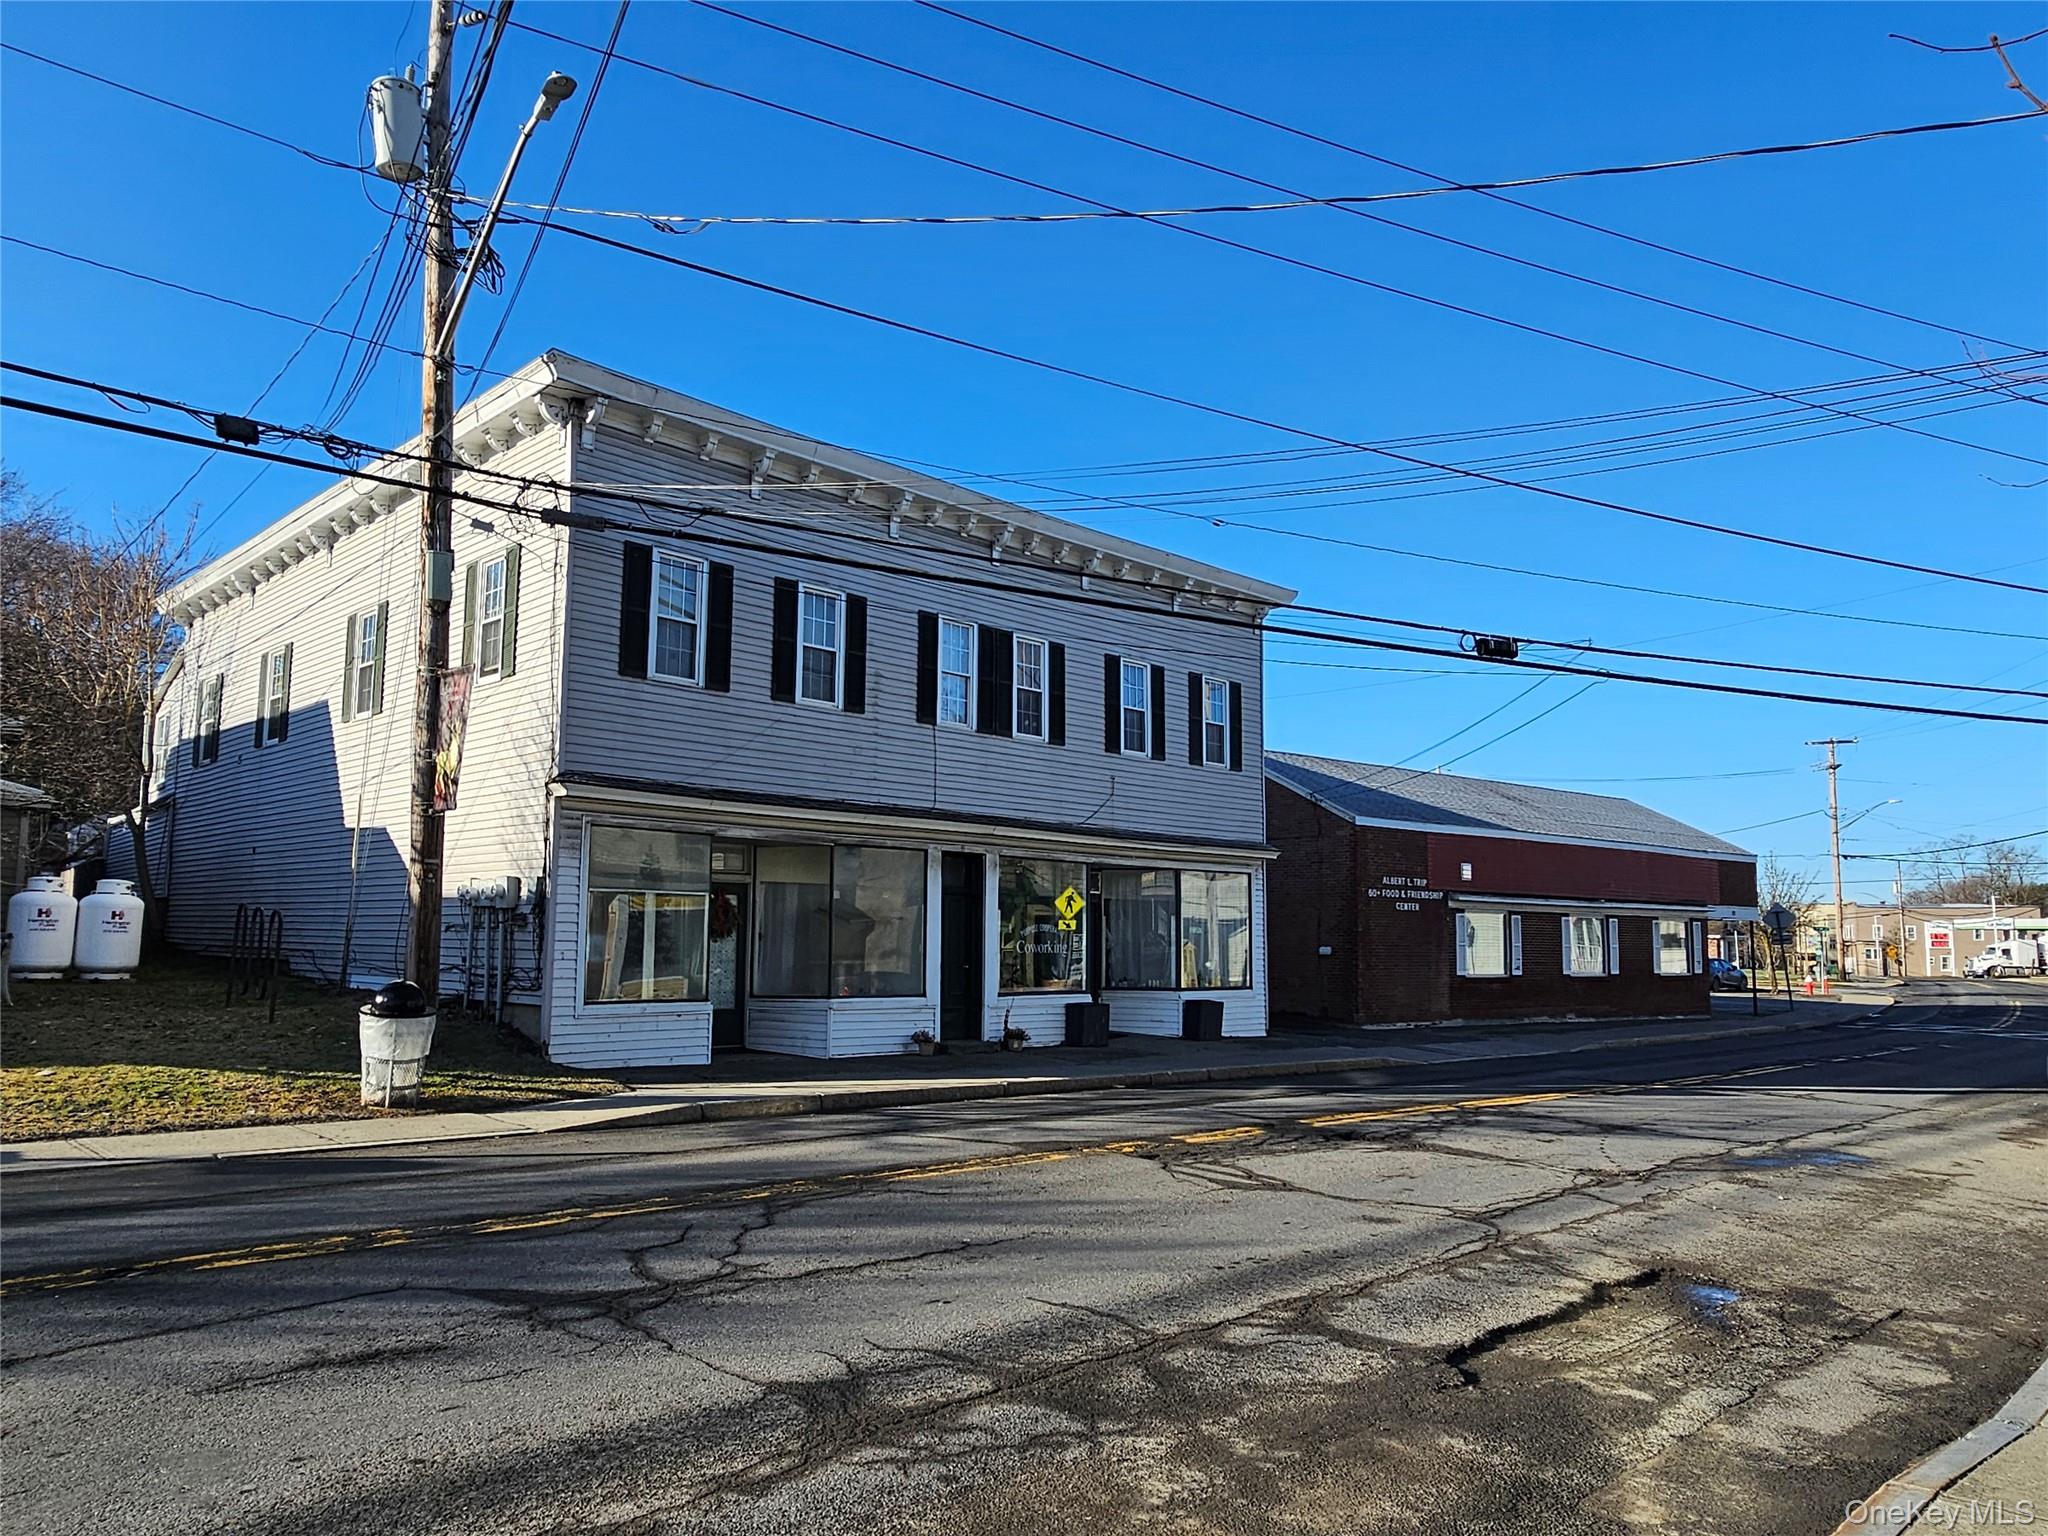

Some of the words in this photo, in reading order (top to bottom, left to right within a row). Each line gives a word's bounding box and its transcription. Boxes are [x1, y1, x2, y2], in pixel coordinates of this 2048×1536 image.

[1382, 876, 1405, 885] ALBERT
[1382, 889, 1399, 898] FOOD
[1407, 890, 1443, 900] FRIENDSHIP
[1395, 902, 1420, 911] CENTER
[1016, 940, 1068, 957] Coworking
